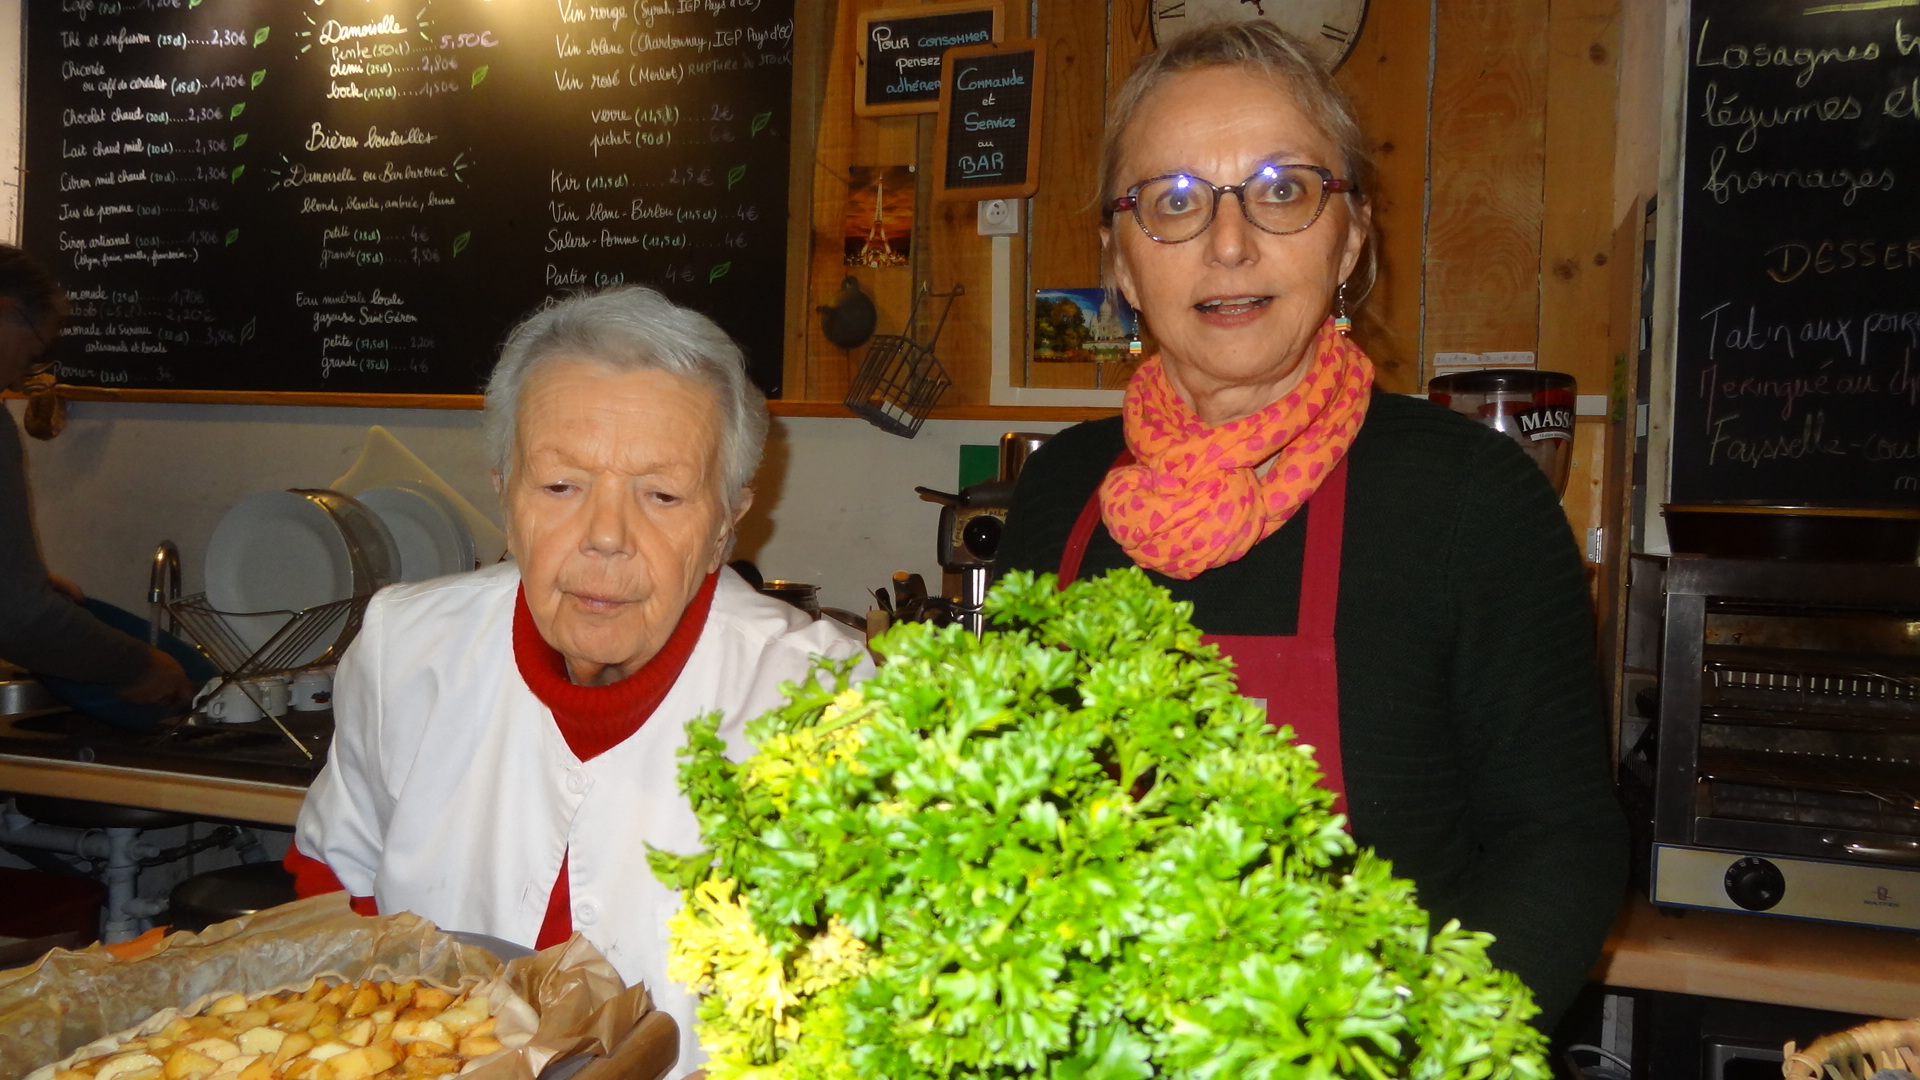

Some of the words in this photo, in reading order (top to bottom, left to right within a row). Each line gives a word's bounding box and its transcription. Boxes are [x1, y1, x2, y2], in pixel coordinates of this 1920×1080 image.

[560, 0, 586, 23] Vin
[590, 3, 628, 31] rouge
[676, 0, 701, 14] IGP
[61, 32, 81, 48] Thé
[87, 34, 98, 48] et
[103, 26, 150, 53] infusion
[211, 29, 247, 48] 2,30€
[439, 31, 500, 49] 5,50€
[556, 32, 581, 59] Vin
[586, 36, 624, 55] blanc
[713, 30, 742, 48] IGP
[747, 28, 771, 50] Pays
[62, 61, 105, 80] Chicorée
[330, 60, 363, 78] demi
[895, 56, 940, 75] pensez
[554, 67, 584, 91] Vin
[590, 71, 621, 89] rosé
[629, 63, 684, 86] (Merlot)
[82, 81, 95, 92] ou
[98, 78, 116, 99] café
[117, 80, 128, 91] de
[326, 80, 363, 99] bock
[982, 92, 996, 106] et
[63, 108, 106, 127] Chocolat
[111, 106, 144, 123] chaud
[591, 110, 632, 124] verre
[711, 104, 734, 122] 2€
[1701, 81, 1861, 152] légumes
[305, 121, 359, 152] Bières
[363, 125, 438, 150] bouteilles
[589, 129, 631, 158] pichet
[977, 140, 994, 148] au
[62, 138, 87, 158] Lait
[92, 140, 120, 157] chaud
[123, 138, 144, 153] miel
[958, 152, 1004, 173] BAR
[60, 172, 92, 192] Citron
[94, 172, 116, 186] miel
[117, 169, 147, 184] chaud
[362, 170, 378, 183] ou
[551, 169, 580, 193] Kir
[1702, 145, 1894, 206] fromages
[427, 191, 456, 207] brune
[59, 203, 80, 221] Jus
[83, 205, 95, 217] de
[97, 204, 134, 224] pomme
[548, 199, 580, 223] Vin
[59, 231, 87, 253] Sirop
[88, 233, 130, 249] artisanal
[322, 225, 350, 247] petite
[320, 247, 357, 269] grande
[545, 263, 588, 286] Pastis
[64, 285, 108, 300] imonade
[295, 291, 319, 307] Eau
[322, 290, 367, 305] minérale
[369, 288, 405, 306] locale
[59, 323, 101, 336] imonade
[105, 323, 116, 336] de
[313, 311, 356, 332] gazeuse
[1700, 301, 1794, 359] Tatin
[1800, 319, 1852, 358] aux
[131, 343, 140, 353] et
[141, 341, 168, 354] locale
[322, 334, 353, 356] petite
[321, 355, 358, 379] grande
[1837, 374, 1879, 394] au
